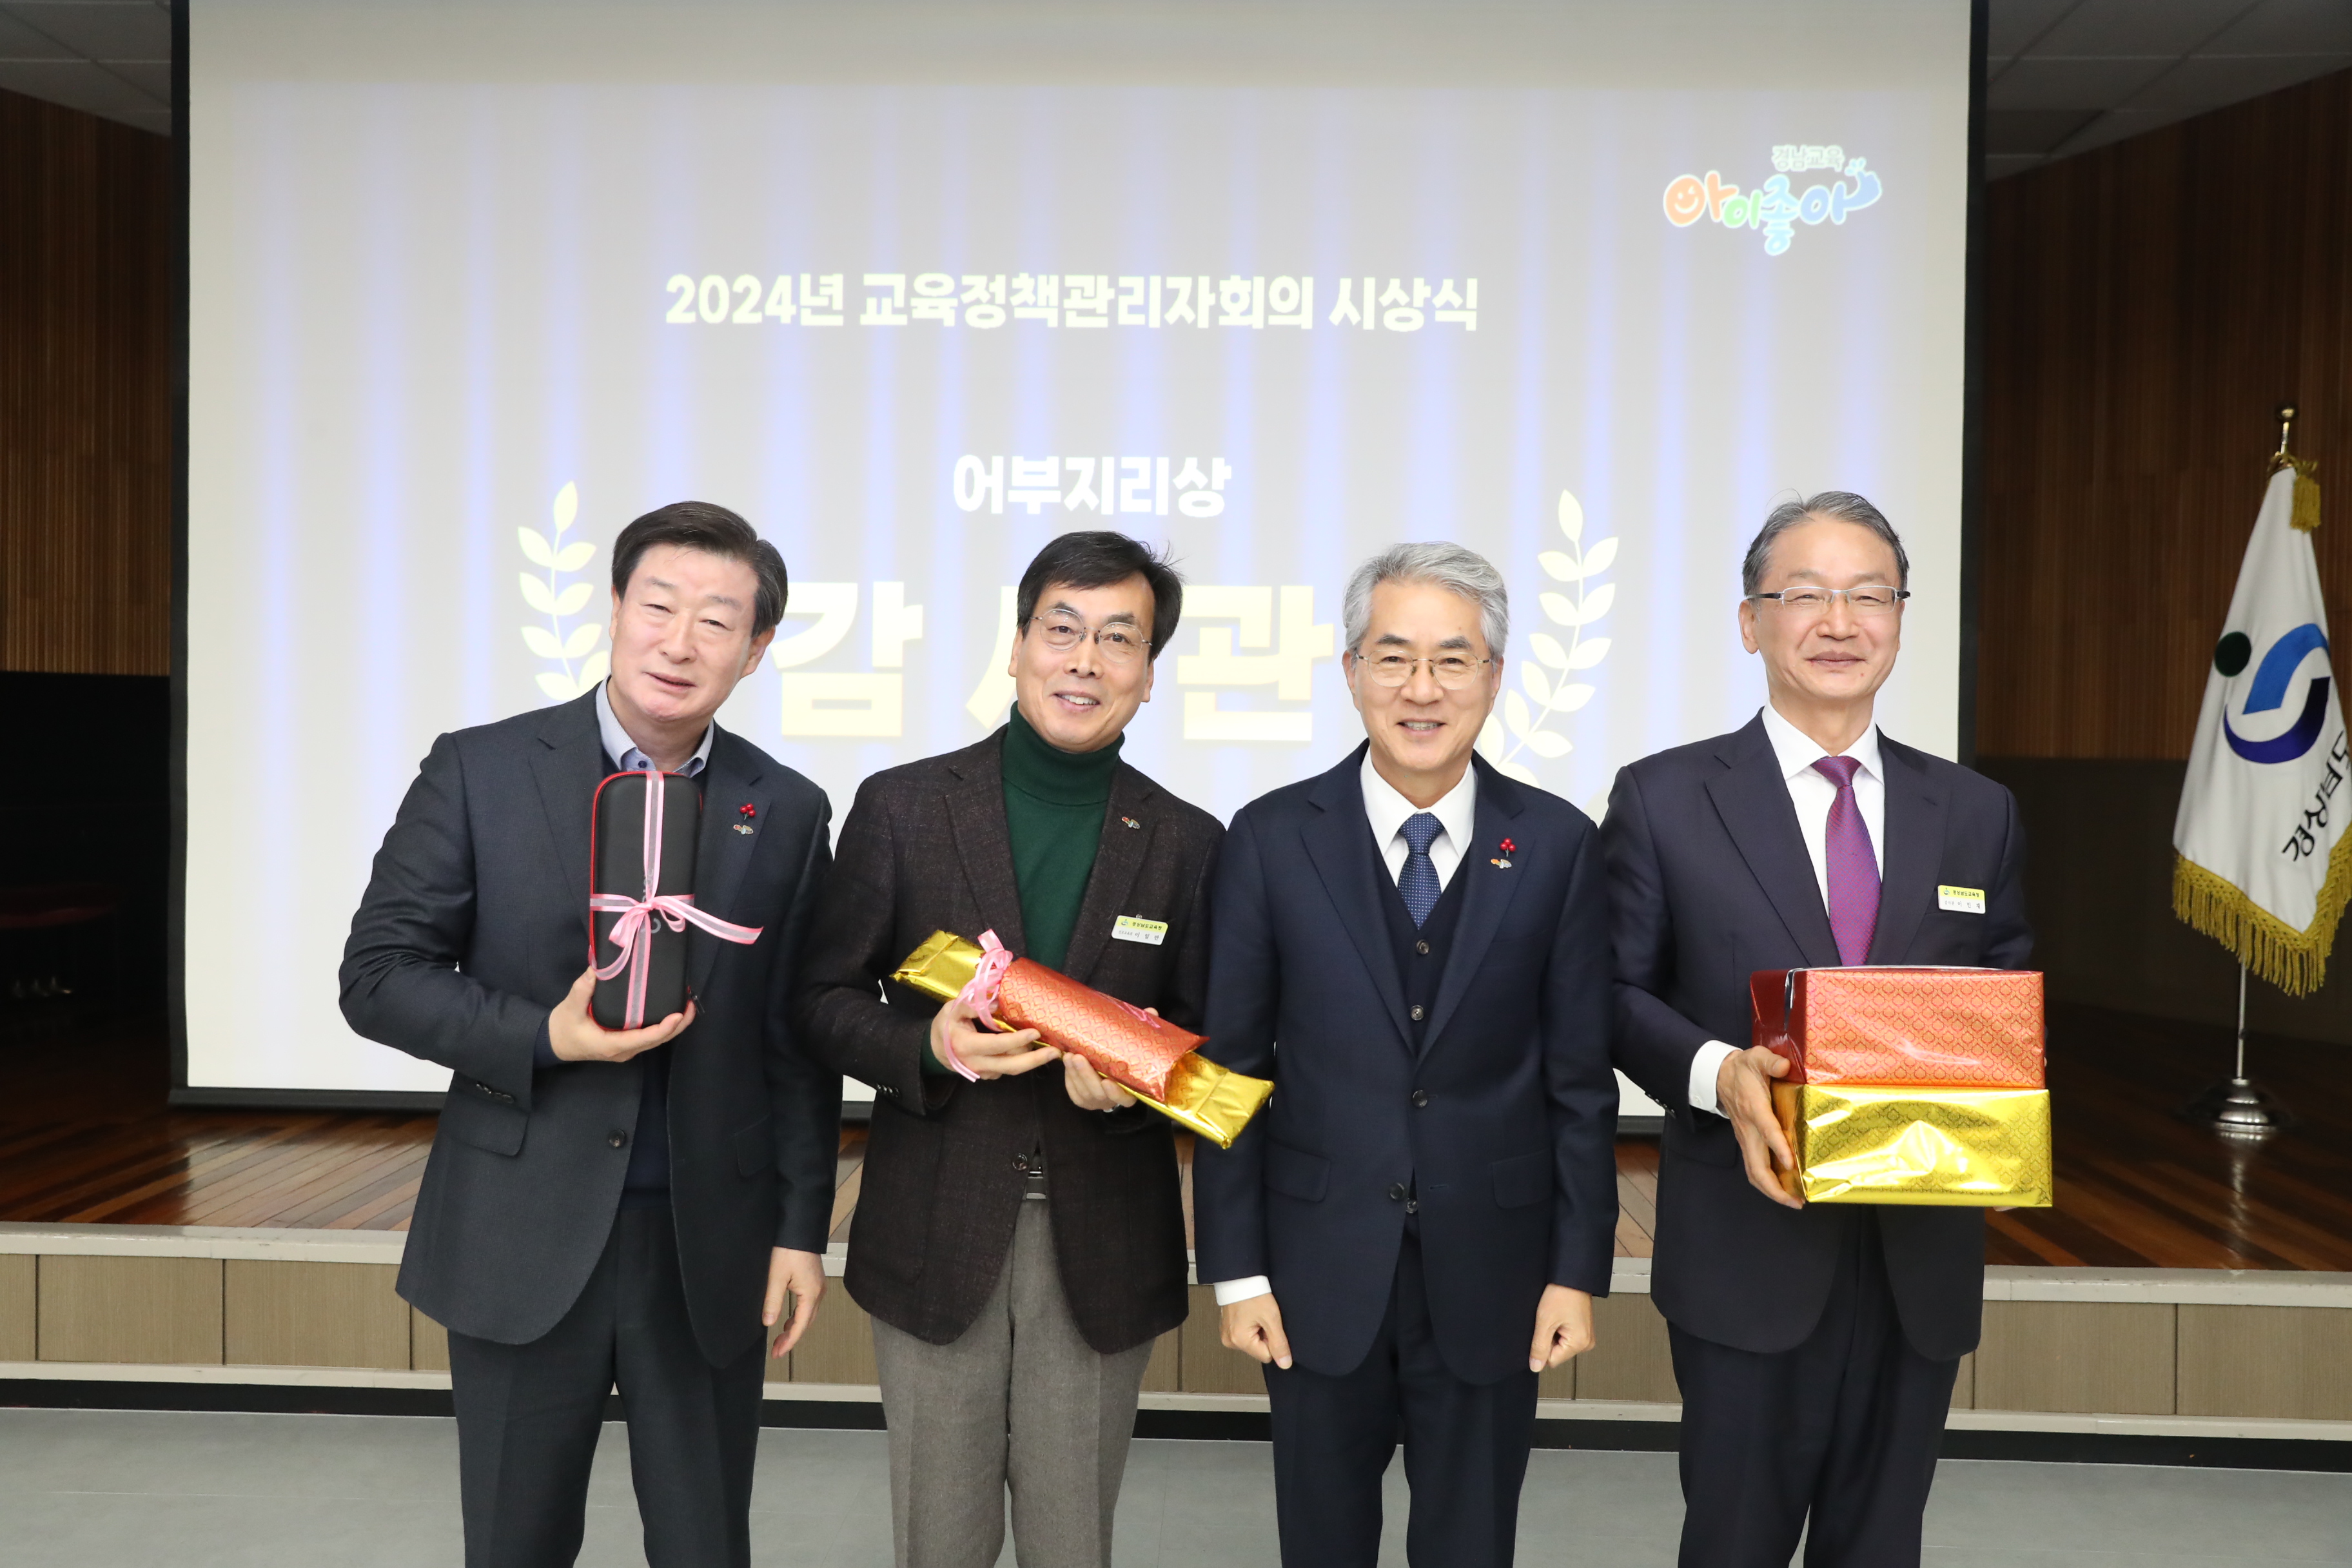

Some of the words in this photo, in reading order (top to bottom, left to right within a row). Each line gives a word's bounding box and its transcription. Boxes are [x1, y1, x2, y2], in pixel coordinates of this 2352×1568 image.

[1772, 145, 1845, 172] 경남교육
[1663, 170, 1882, 257] 아이좋아
[666, 273, 844, 326] 2024년
[860, 273, 1313, 329] 교육정책관리자회의
[1329, 277, 1478, 332] 시상식
[954, 454, 1232, 518] 어부지리상
